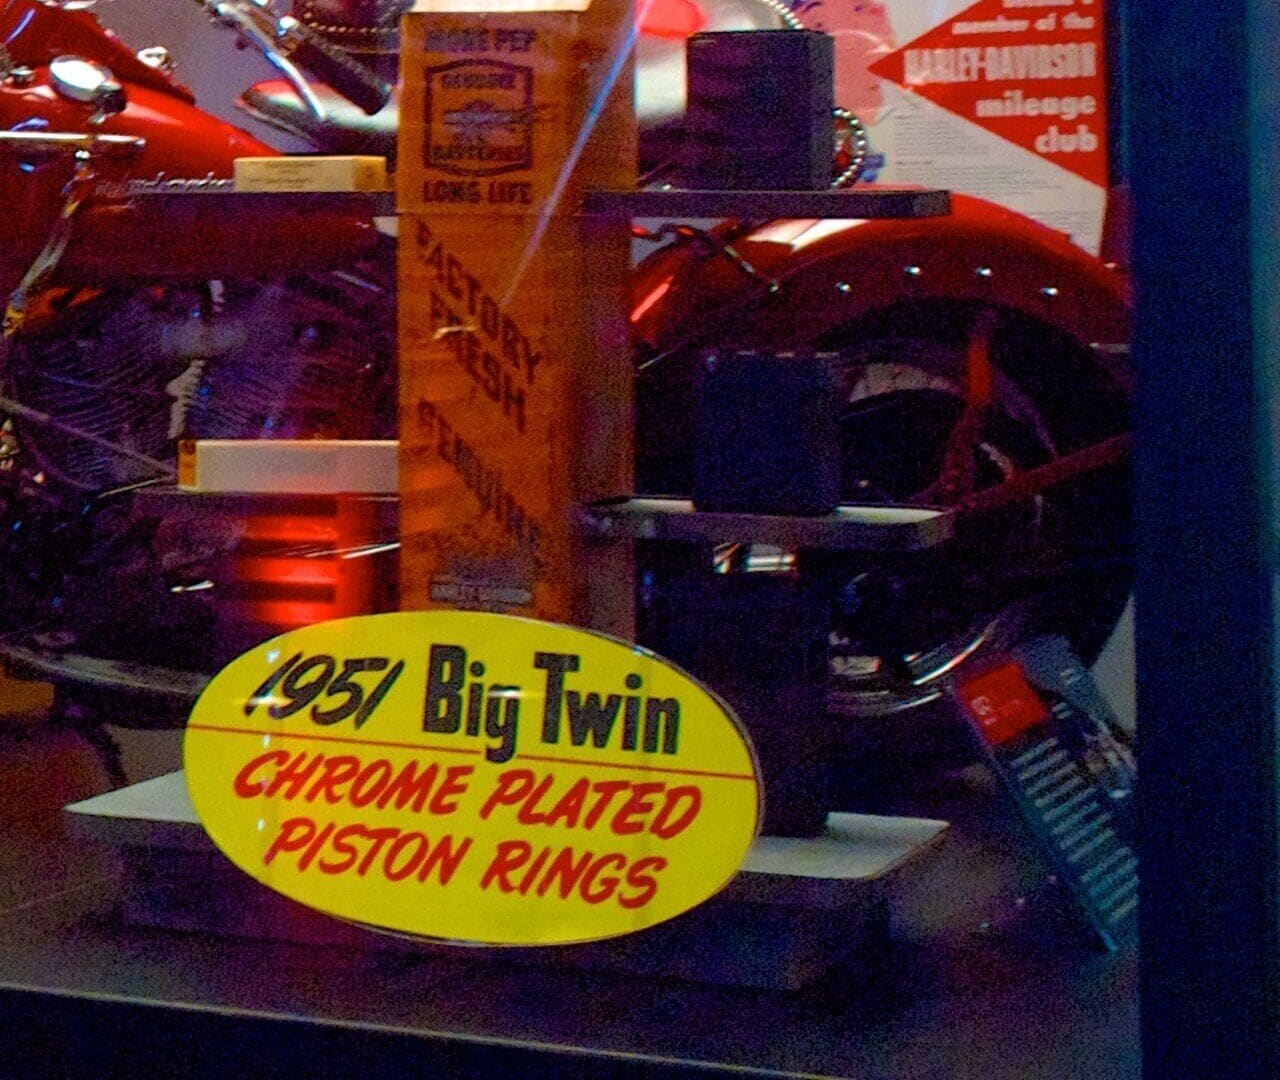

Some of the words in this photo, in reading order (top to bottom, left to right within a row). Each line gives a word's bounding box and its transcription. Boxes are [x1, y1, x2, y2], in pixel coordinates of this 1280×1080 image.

[1062, 13, 1097, 31] the
[902, 41, 1098, 86] HARLEY-DAVIDSON
[975, 89, 1098, 121] mileage
[1035, 124, 1099, 155] club
[422, 179, 481, 203] LONG
[487, 180, 534, 205] LIFE
[416, 219, 541, 386] FACTORY
[429, 290, 527, 436] FRESH
[243, 650, 406, 731] 1951
[420, 642, 524, 765] Big
[533, 649, 682, 757] Twin
[232, 748, 476, 820] CHROME
[478, 765, 703, 841] PLATED
[261, 816, 475, 888] PISTON
[478, 838, 670, 911] RINGS
